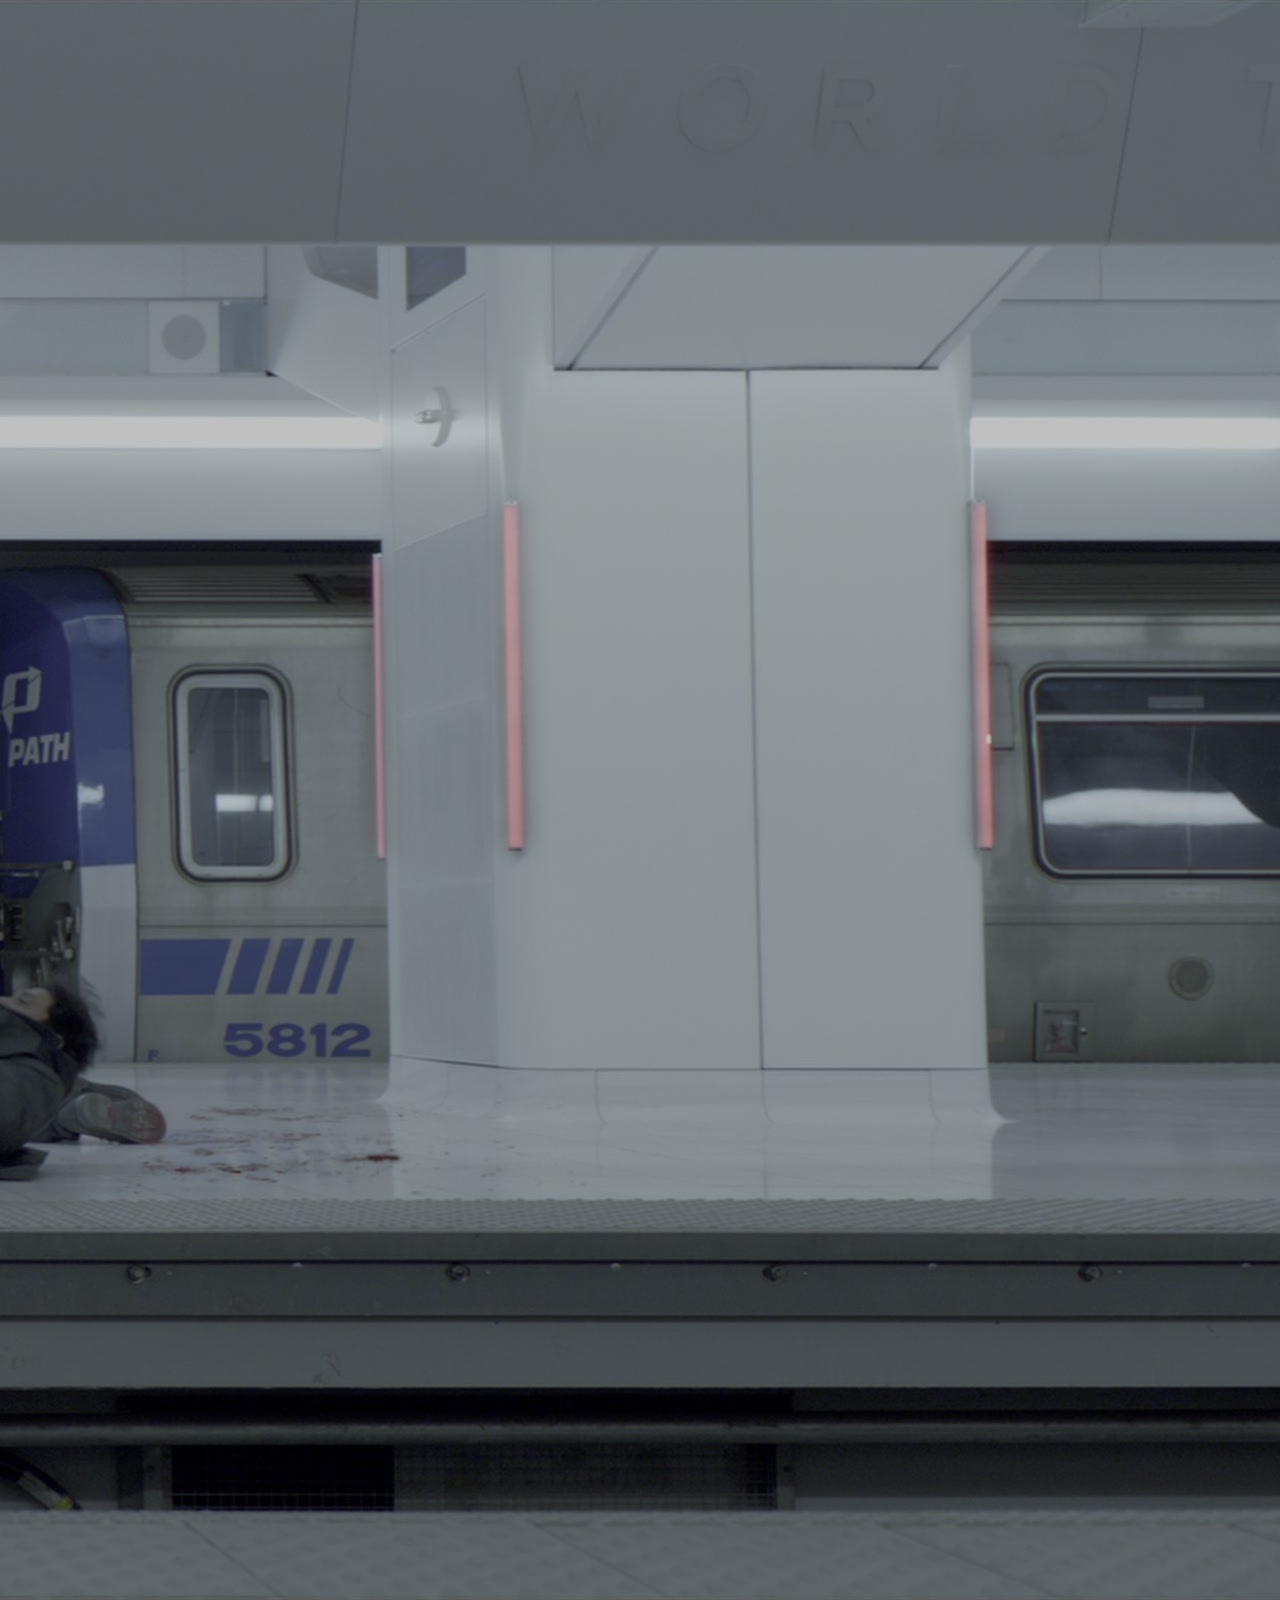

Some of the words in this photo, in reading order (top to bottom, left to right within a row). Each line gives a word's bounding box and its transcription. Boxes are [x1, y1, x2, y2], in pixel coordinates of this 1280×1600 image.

[516, 60, 1121, 156] WORLD
[7, 731, 71, 768] PATH
[224, 1022, 371, 1058] 5812
